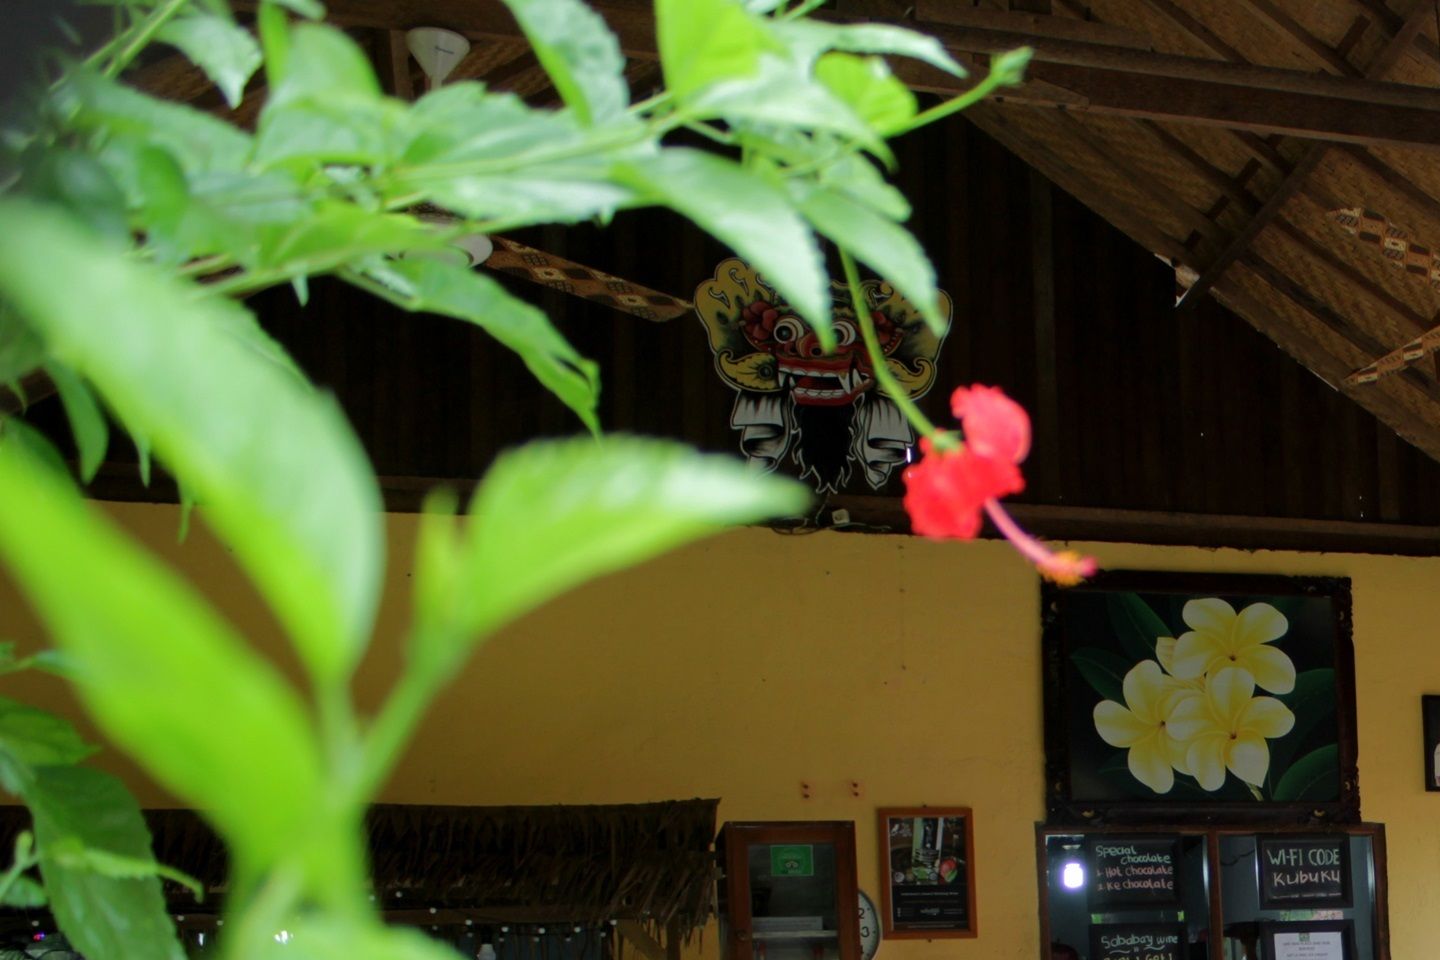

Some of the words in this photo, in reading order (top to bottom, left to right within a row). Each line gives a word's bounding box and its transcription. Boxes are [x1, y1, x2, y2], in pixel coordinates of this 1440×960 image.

[1308, 848, 1340, 866] CODE
[1105, 866, 1123, 878] Hot
[861, 926, 870, 938] 3
